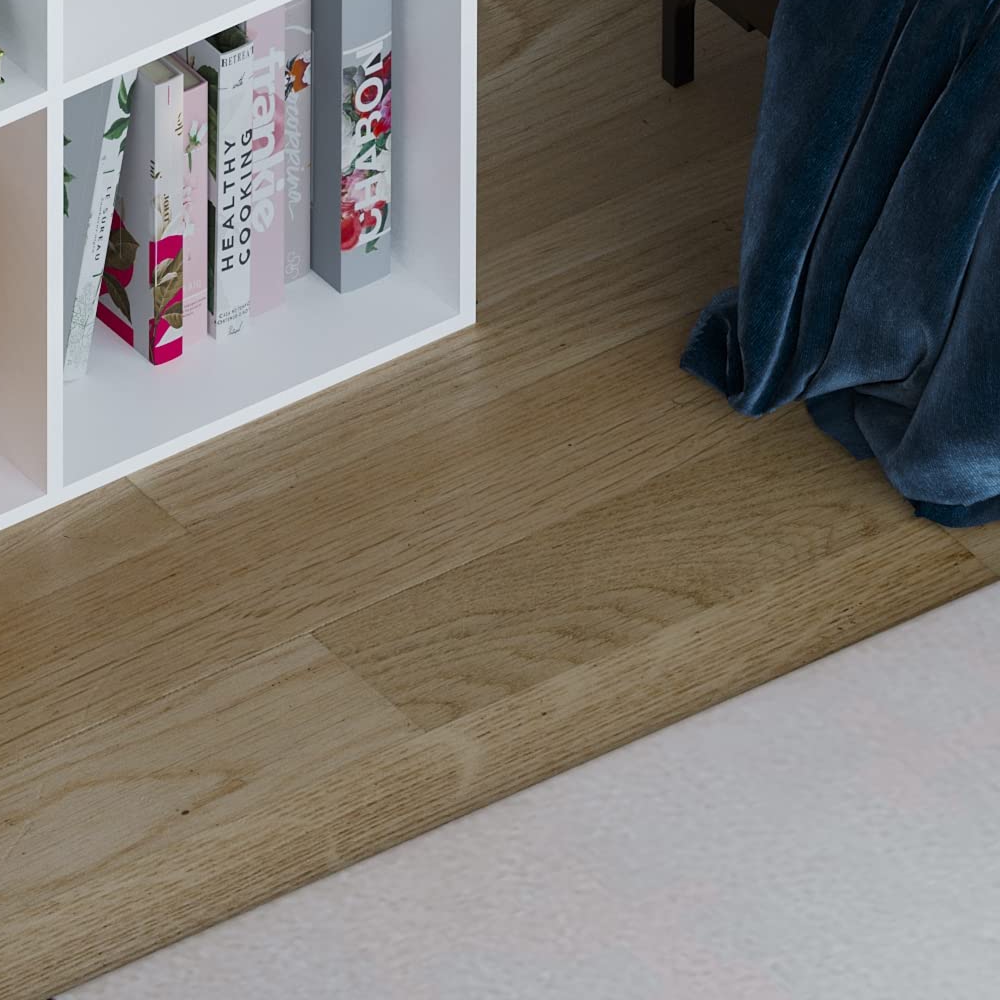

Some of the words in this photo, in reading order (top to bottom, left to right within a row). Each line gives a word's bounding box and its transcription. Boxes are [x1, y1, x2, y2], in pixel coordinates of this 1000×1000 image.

[220, 140, 237, 272] HEALTHY
[238, 128, 253, 265] COOKING
[252, 46, 286, 233] frankie
